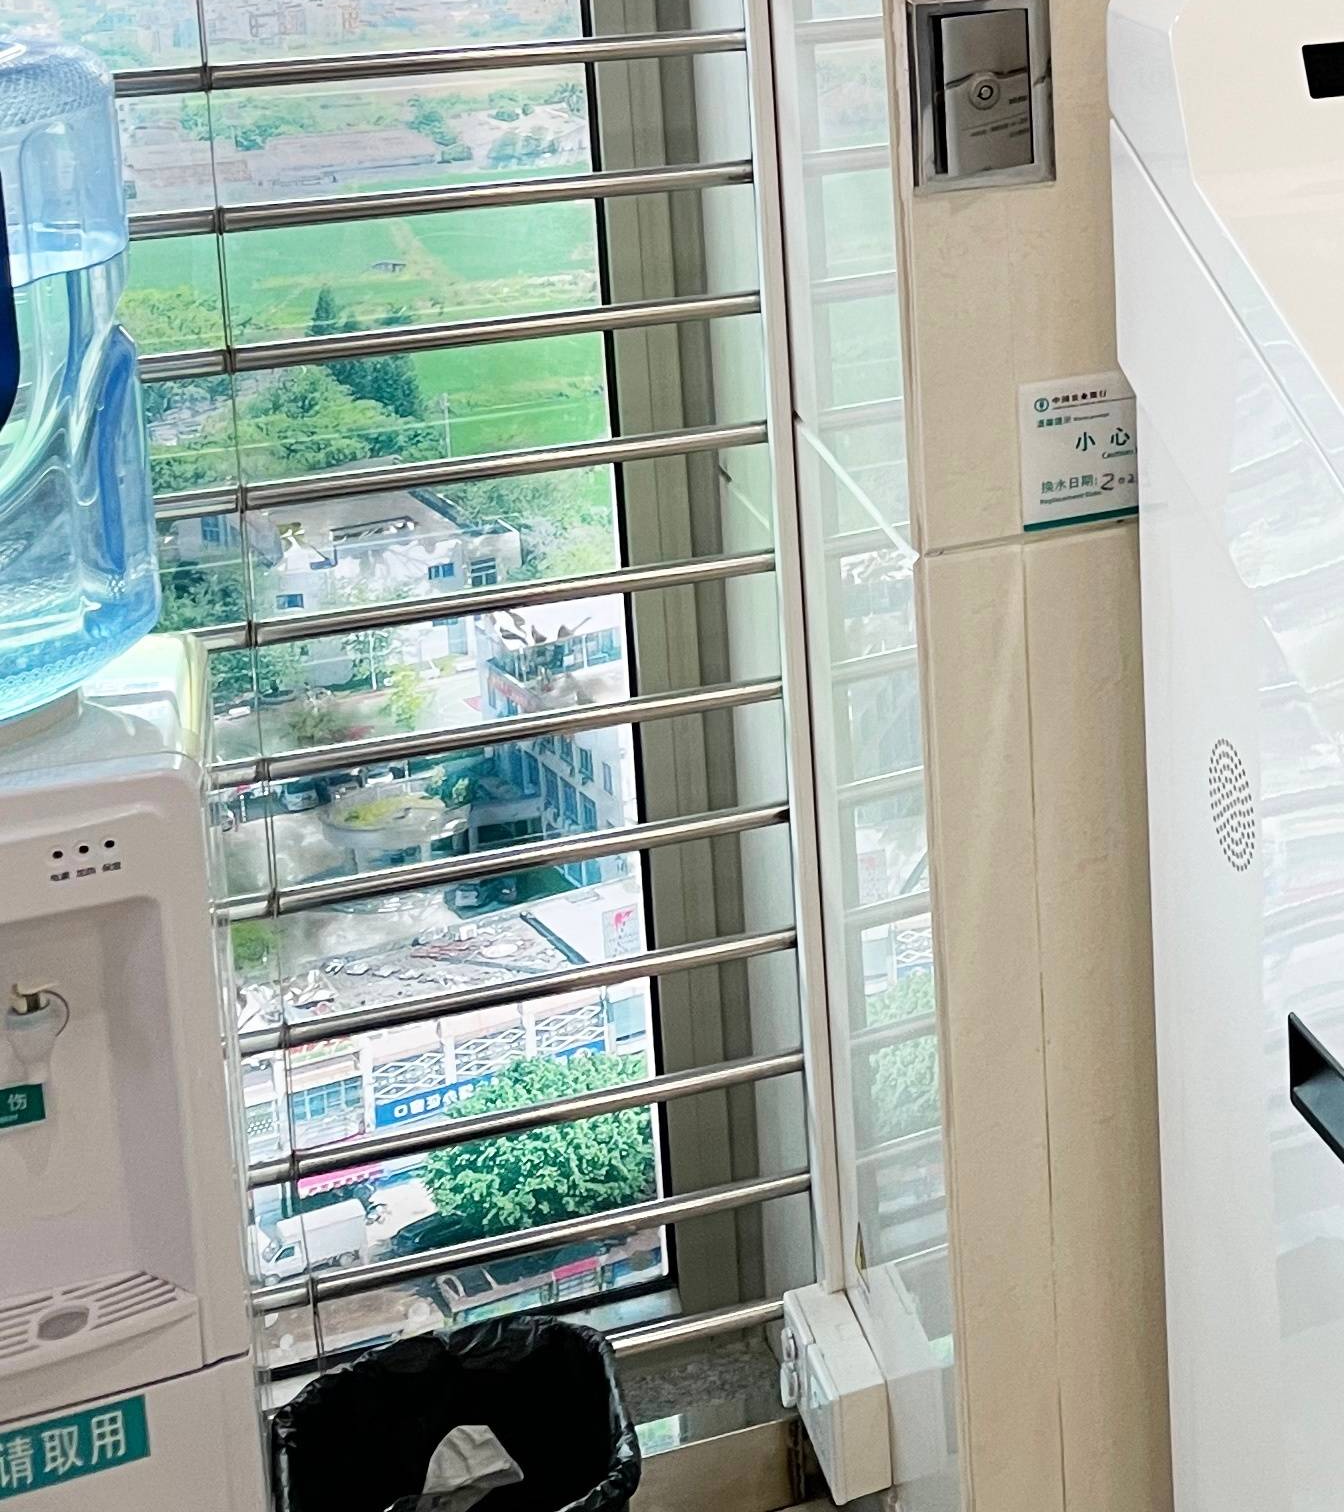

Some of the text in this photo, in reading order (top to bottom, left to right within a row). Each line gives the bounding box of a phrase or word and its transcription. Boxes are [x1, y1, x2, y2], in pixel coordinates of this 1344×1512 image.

[1075, 427, 1130, 452] 小心
[0, 1410, 127, 1489] 请取用
